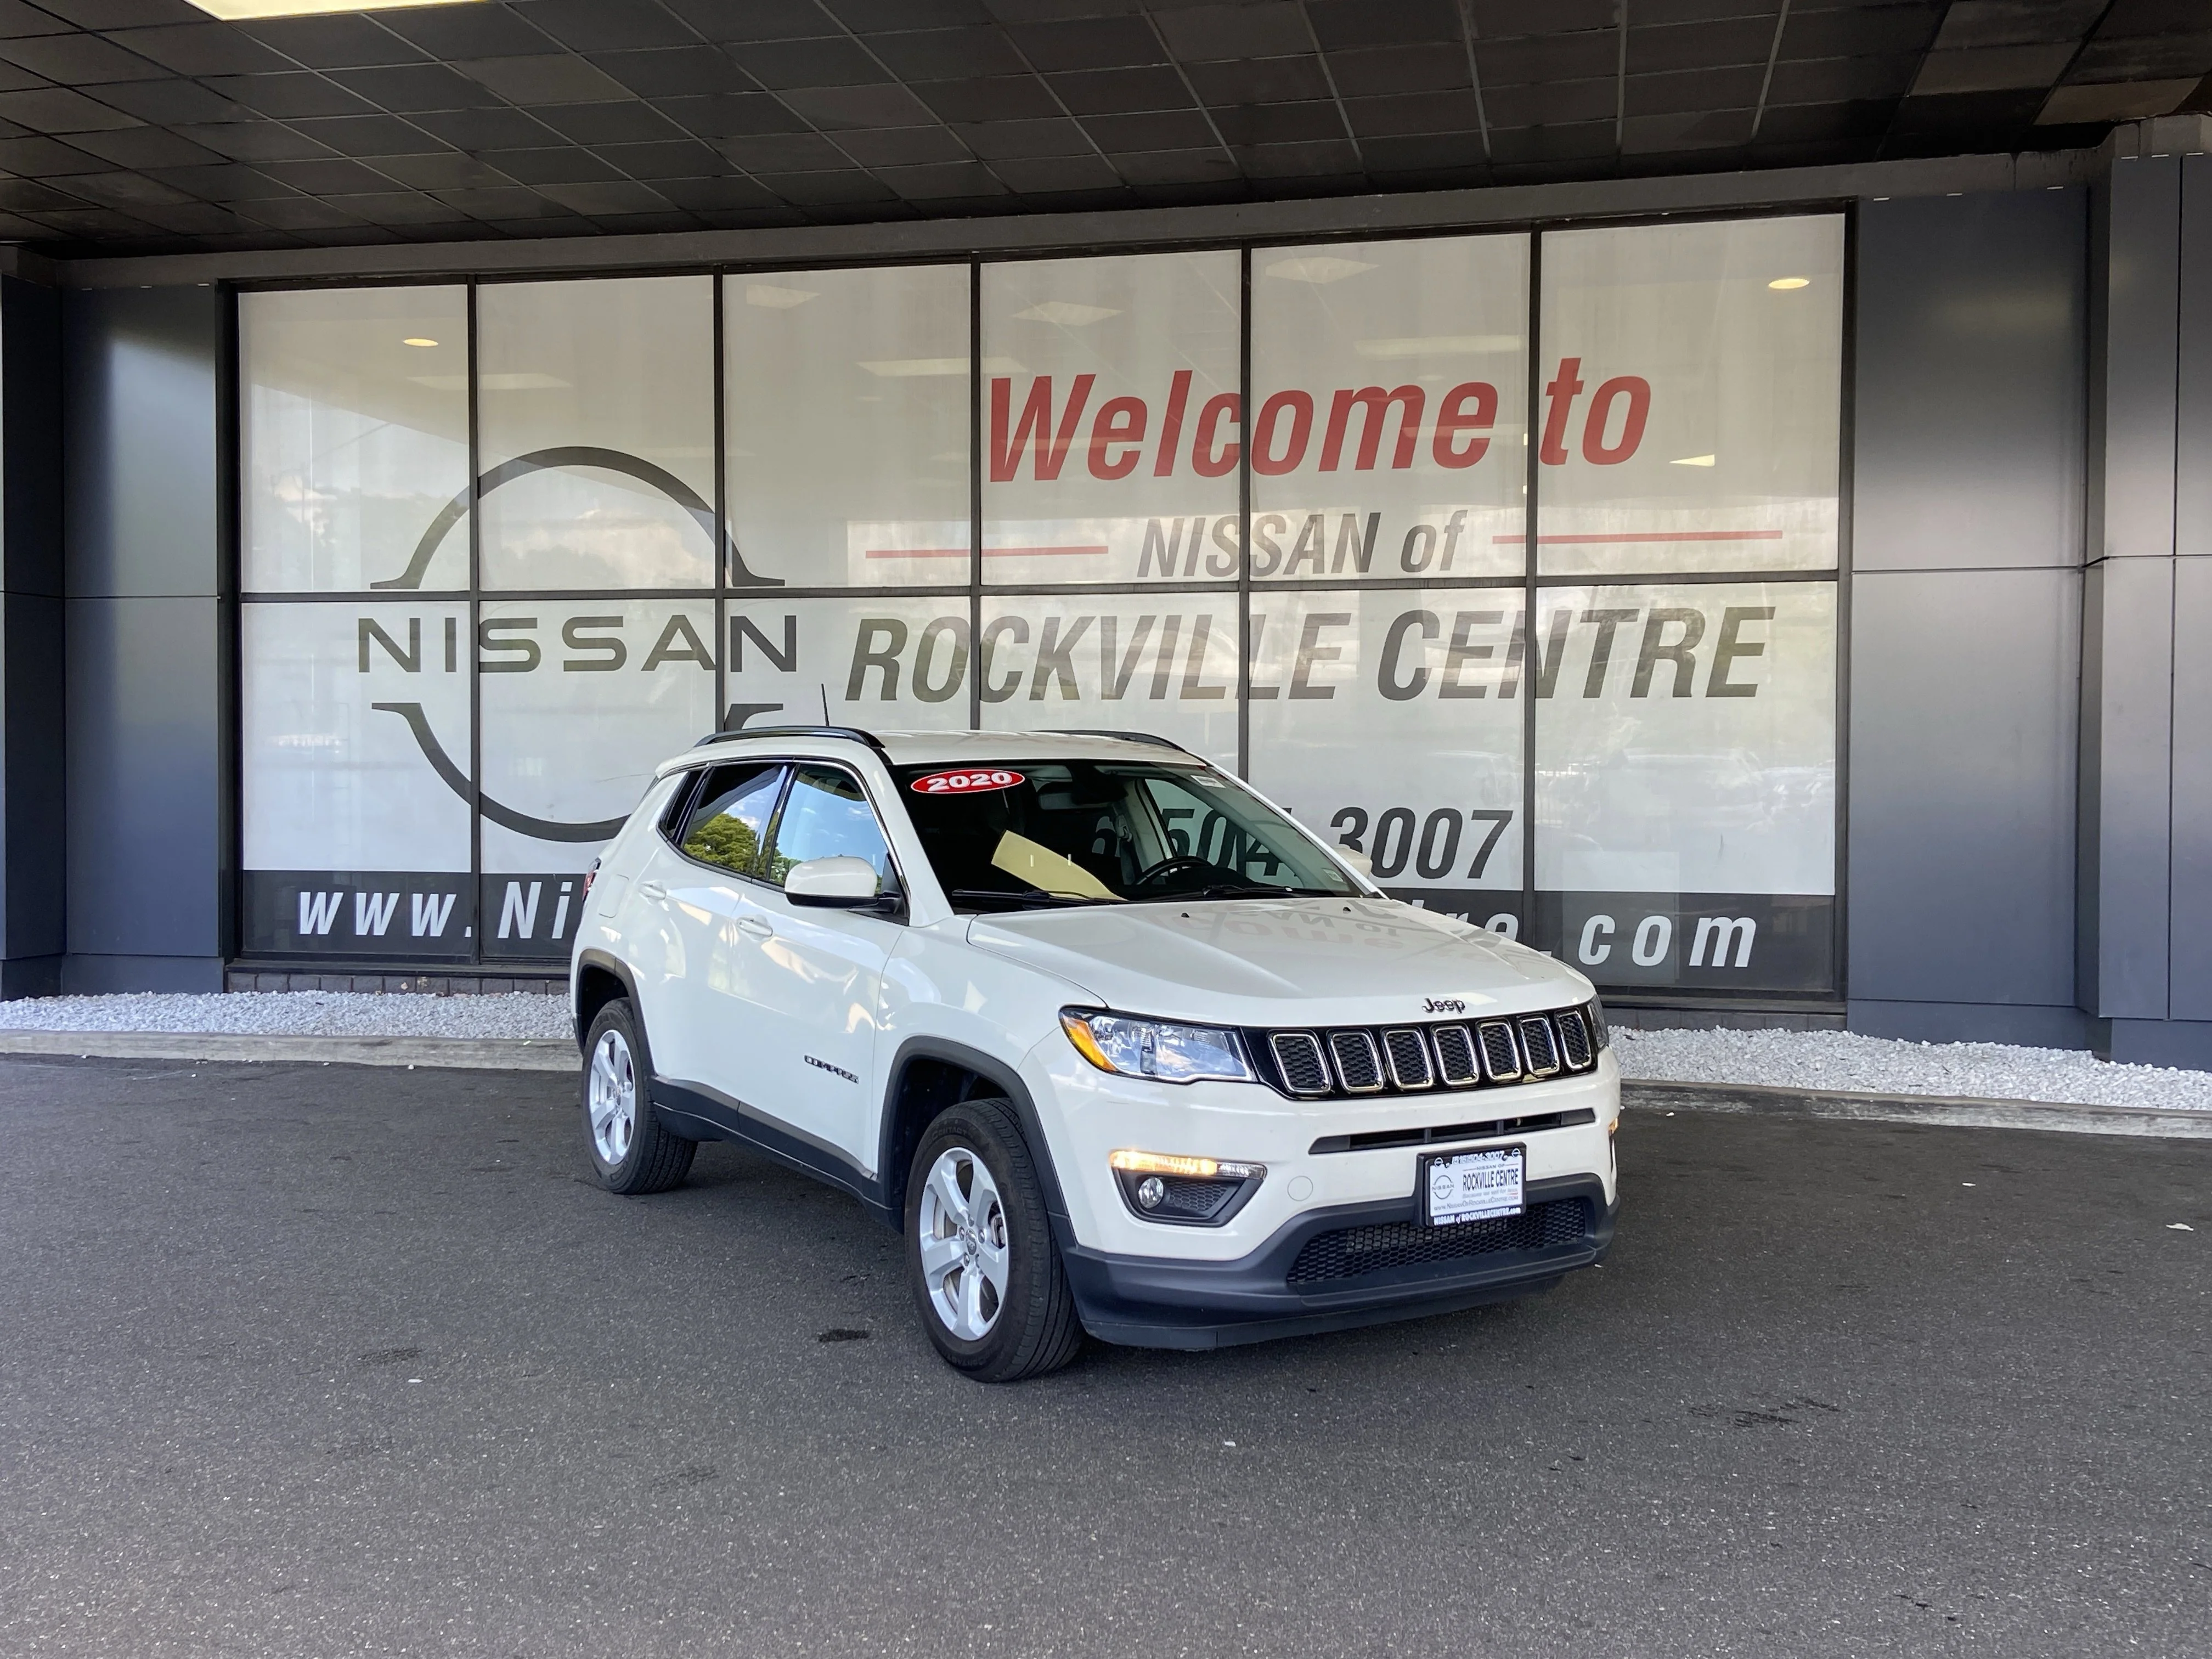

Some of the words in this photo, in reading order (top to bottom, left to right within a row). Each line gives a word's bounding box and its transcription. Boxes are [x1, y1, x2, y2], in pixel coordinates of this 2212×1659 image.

[989, 370, 1498, 482] Welcome
[1538, 357, 1651, 465] to
[1137, 511, 1381, 578] NISSAN
[1401, 510, 1469, 573] of
[358, 614, 797, 673] NISSAN
[844, 612, 1352, 703] ROCKVILLE
[1377, 606, 1776, 701] CENTRE
[927, 772, 1012, 792] 2020
[1421, 998, 1465, 1014] Jeep
[1463, 1170, 1494, 1192] ROCKVILLE
[1496, 1167, 1519, 1188] CENTRE
[1434, 1214, 1455, 1226] NISSAN
